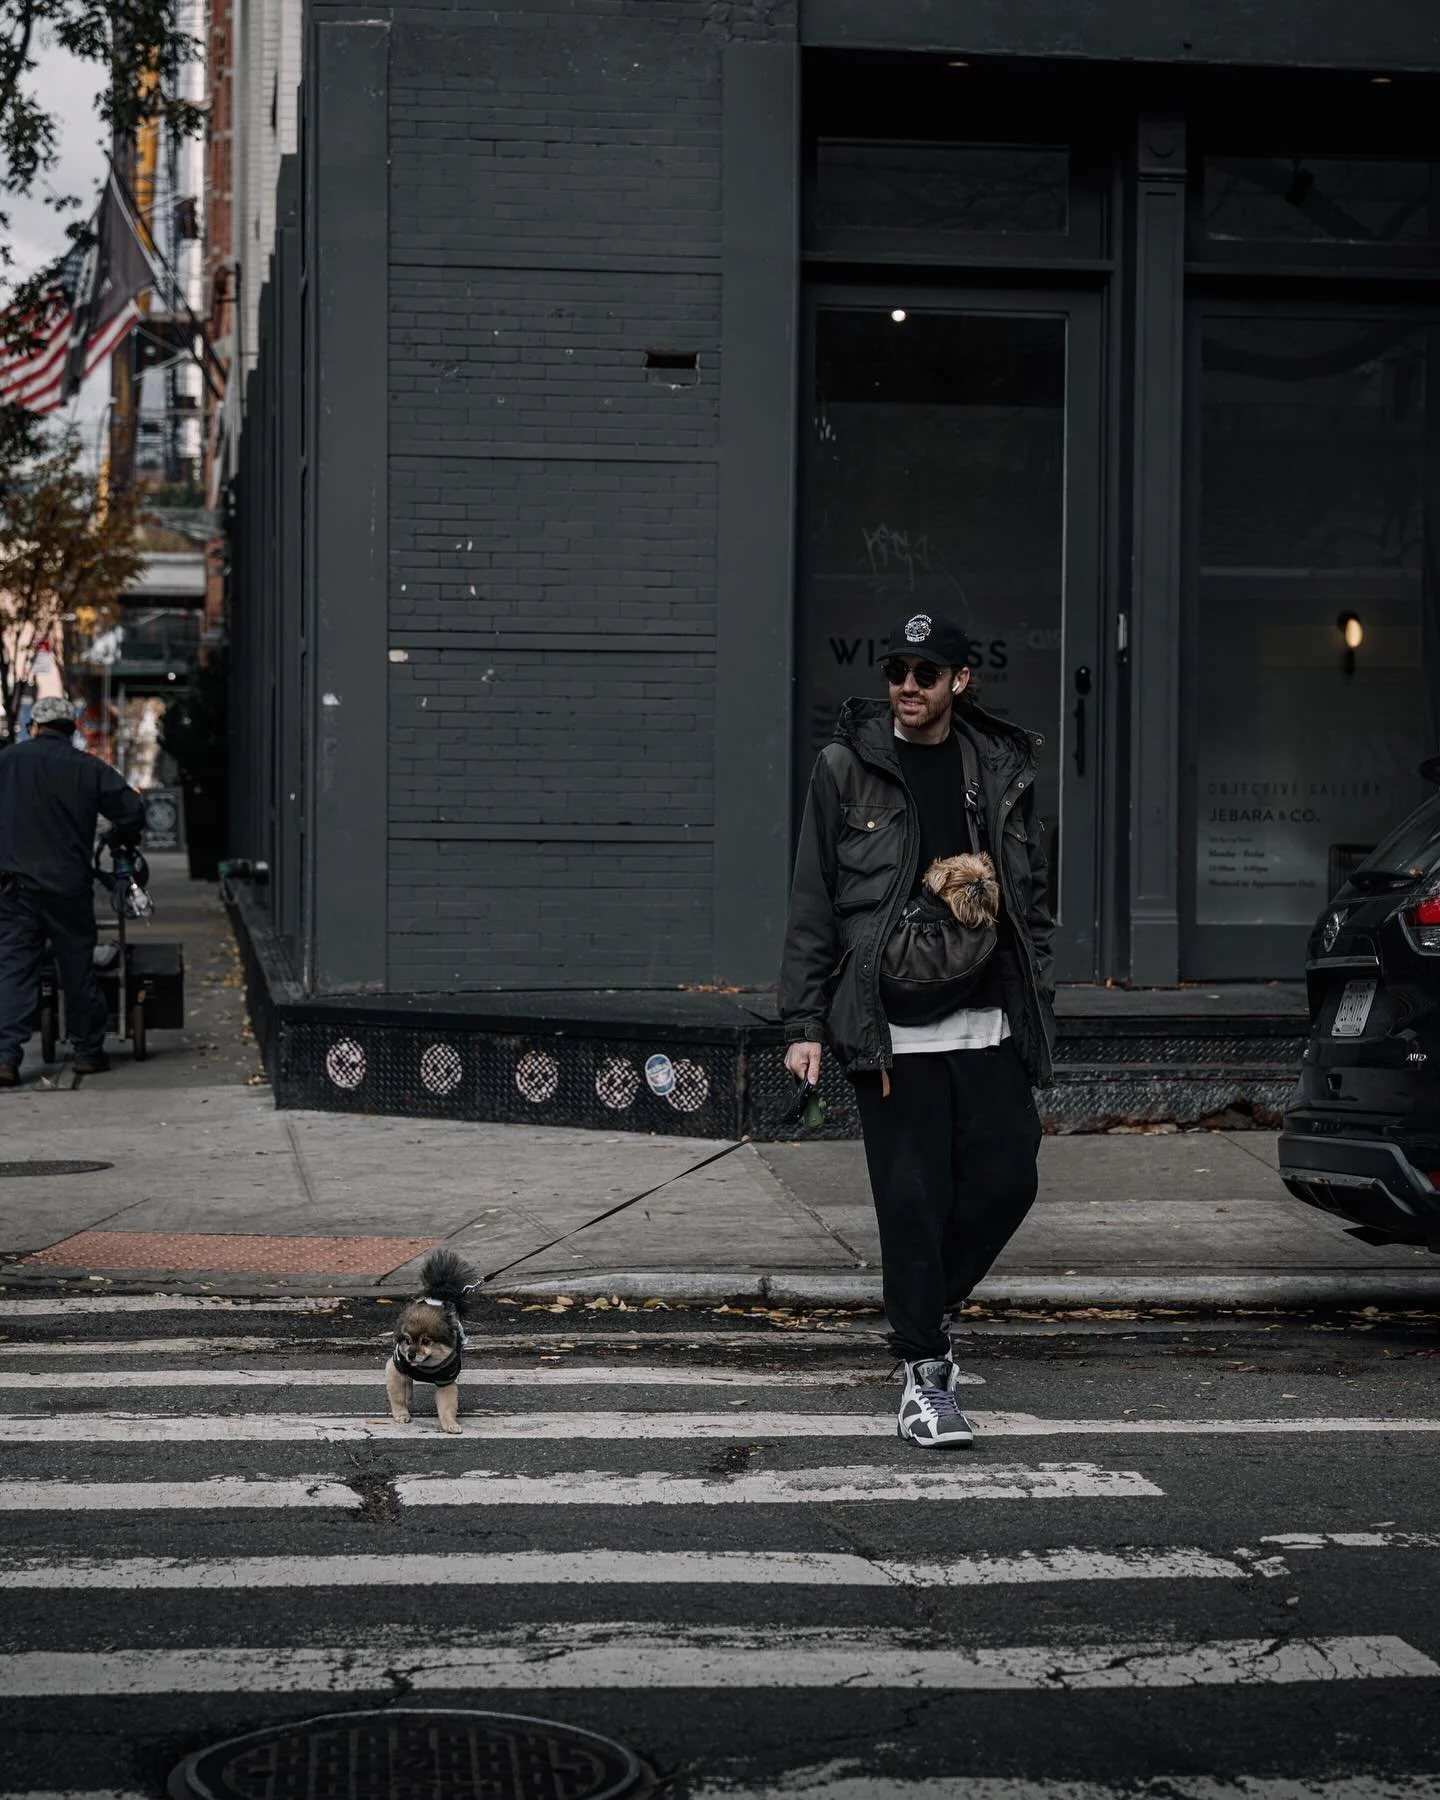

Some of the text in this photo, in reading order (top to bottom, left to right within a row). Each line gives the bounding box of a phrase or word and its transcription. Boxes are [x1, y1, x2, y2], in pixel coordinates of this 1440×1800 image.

[829, 637, 1008, 669] WISS
[1208, 782, 1382, 797] OBJECTIVE GALLERY
